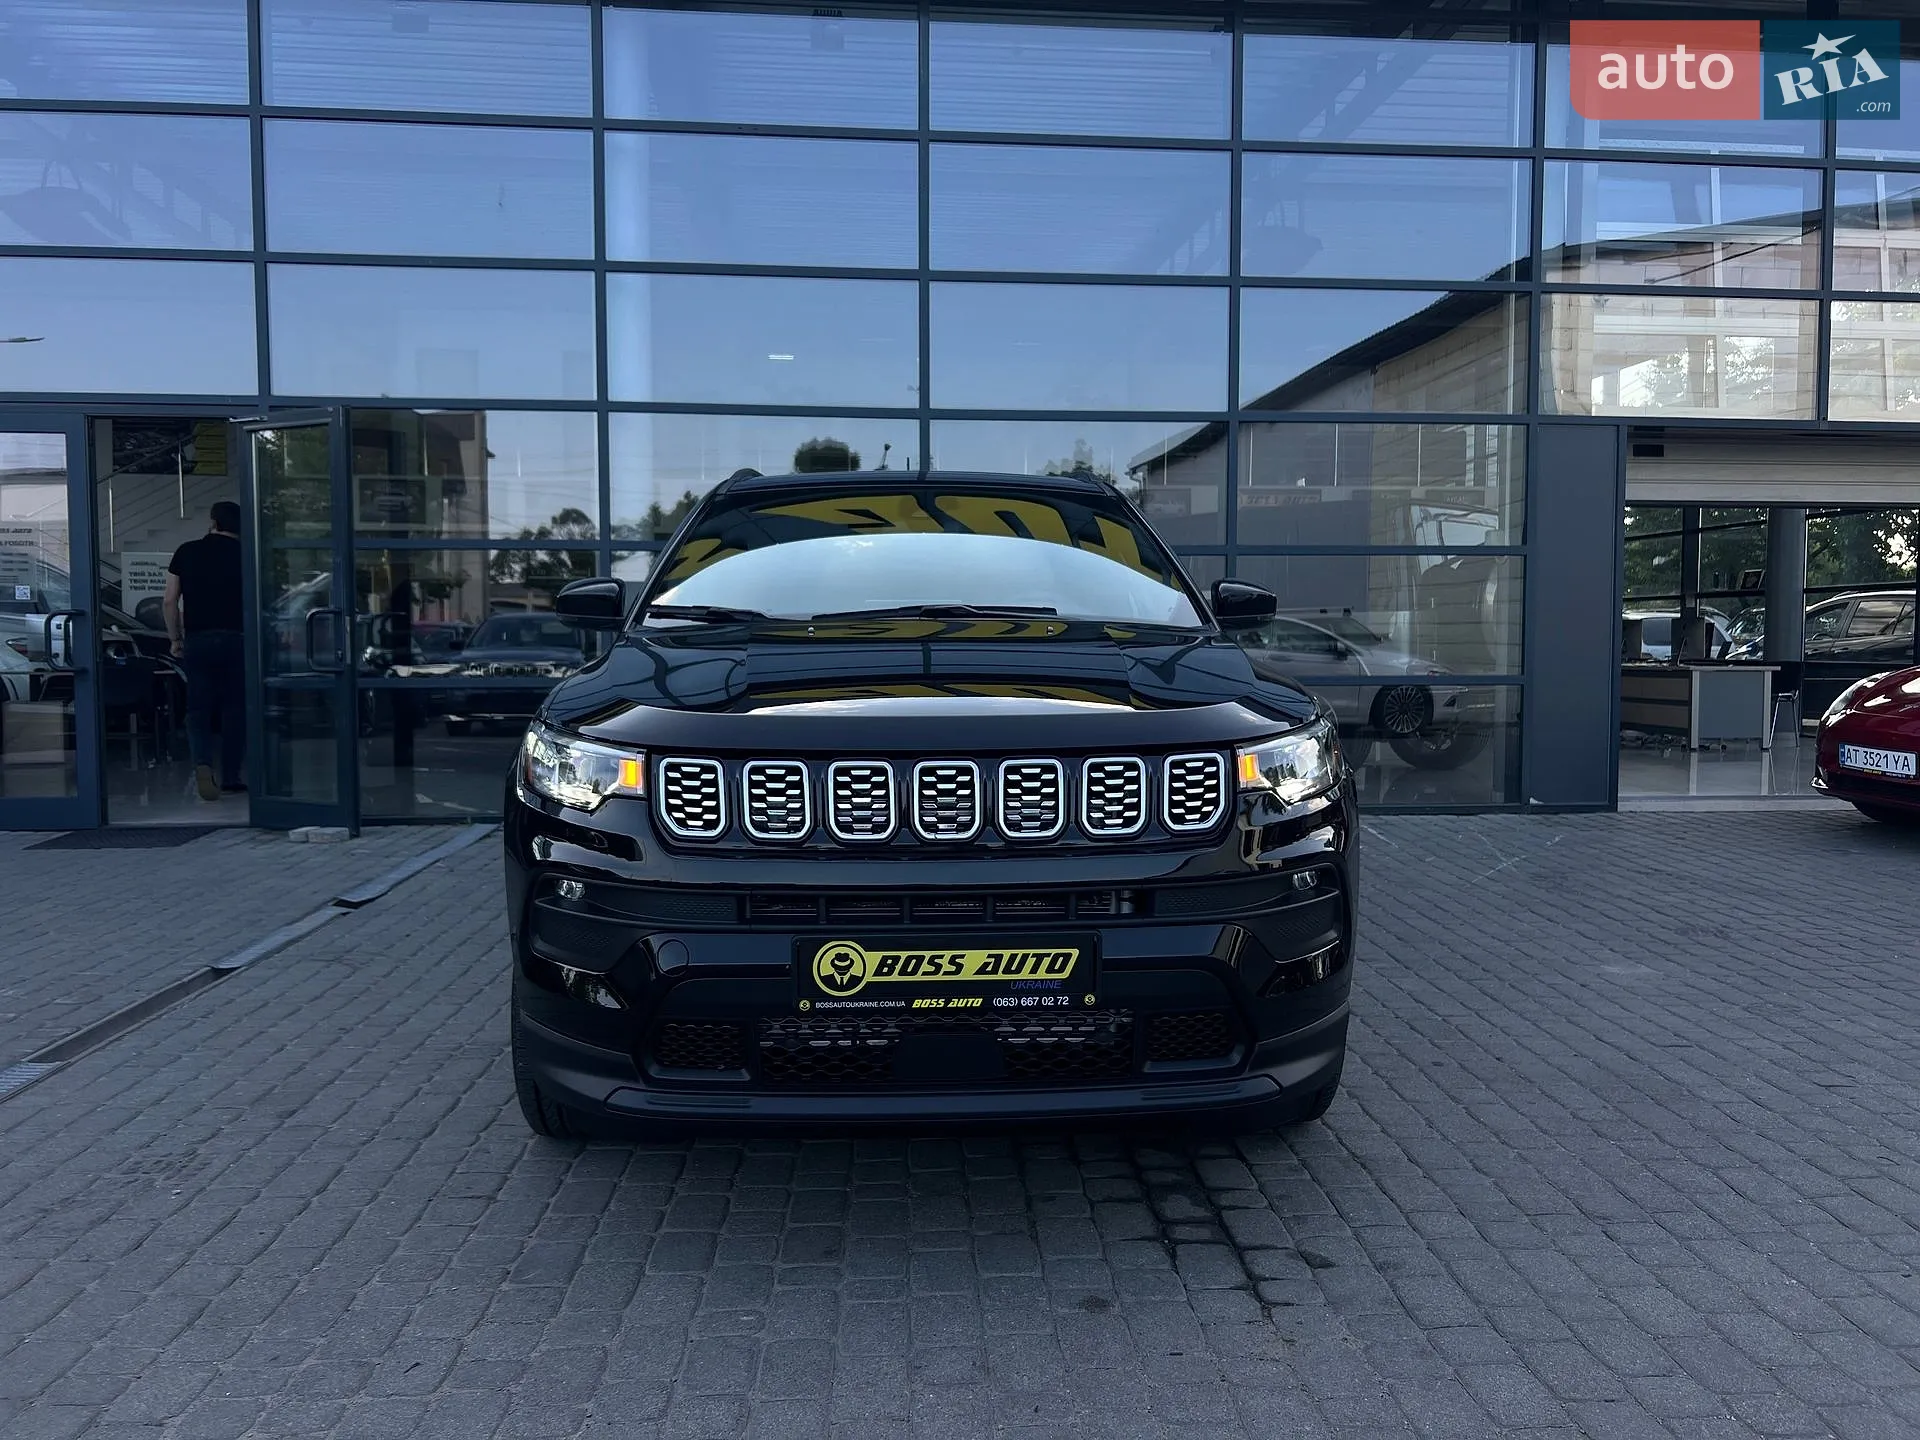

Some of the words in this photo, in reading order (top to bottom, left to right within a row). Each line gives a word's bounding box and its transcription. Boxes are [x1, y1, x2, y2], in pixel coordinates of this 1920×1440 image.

[1846, 747, 1859, 764] AT
[1862, 750, 1889, 769] 3521
[1892, 754, 1911, 772] YA
[872, 953, 966, 977] BOSS
[973, 952, 1073, 976] AUTO
[1010, 980, 1062, 990] UKRAINE
[912, 998, 945, 1008] BOSS
[947, 997, 983, 1007] AUTO
[993, 997, 1018, 1007] (063)
[1020, 997, 1038, 1007] 667
[1041, 996, 1054, 1006] 02
[1057, 996, 1069, 1006] 72
